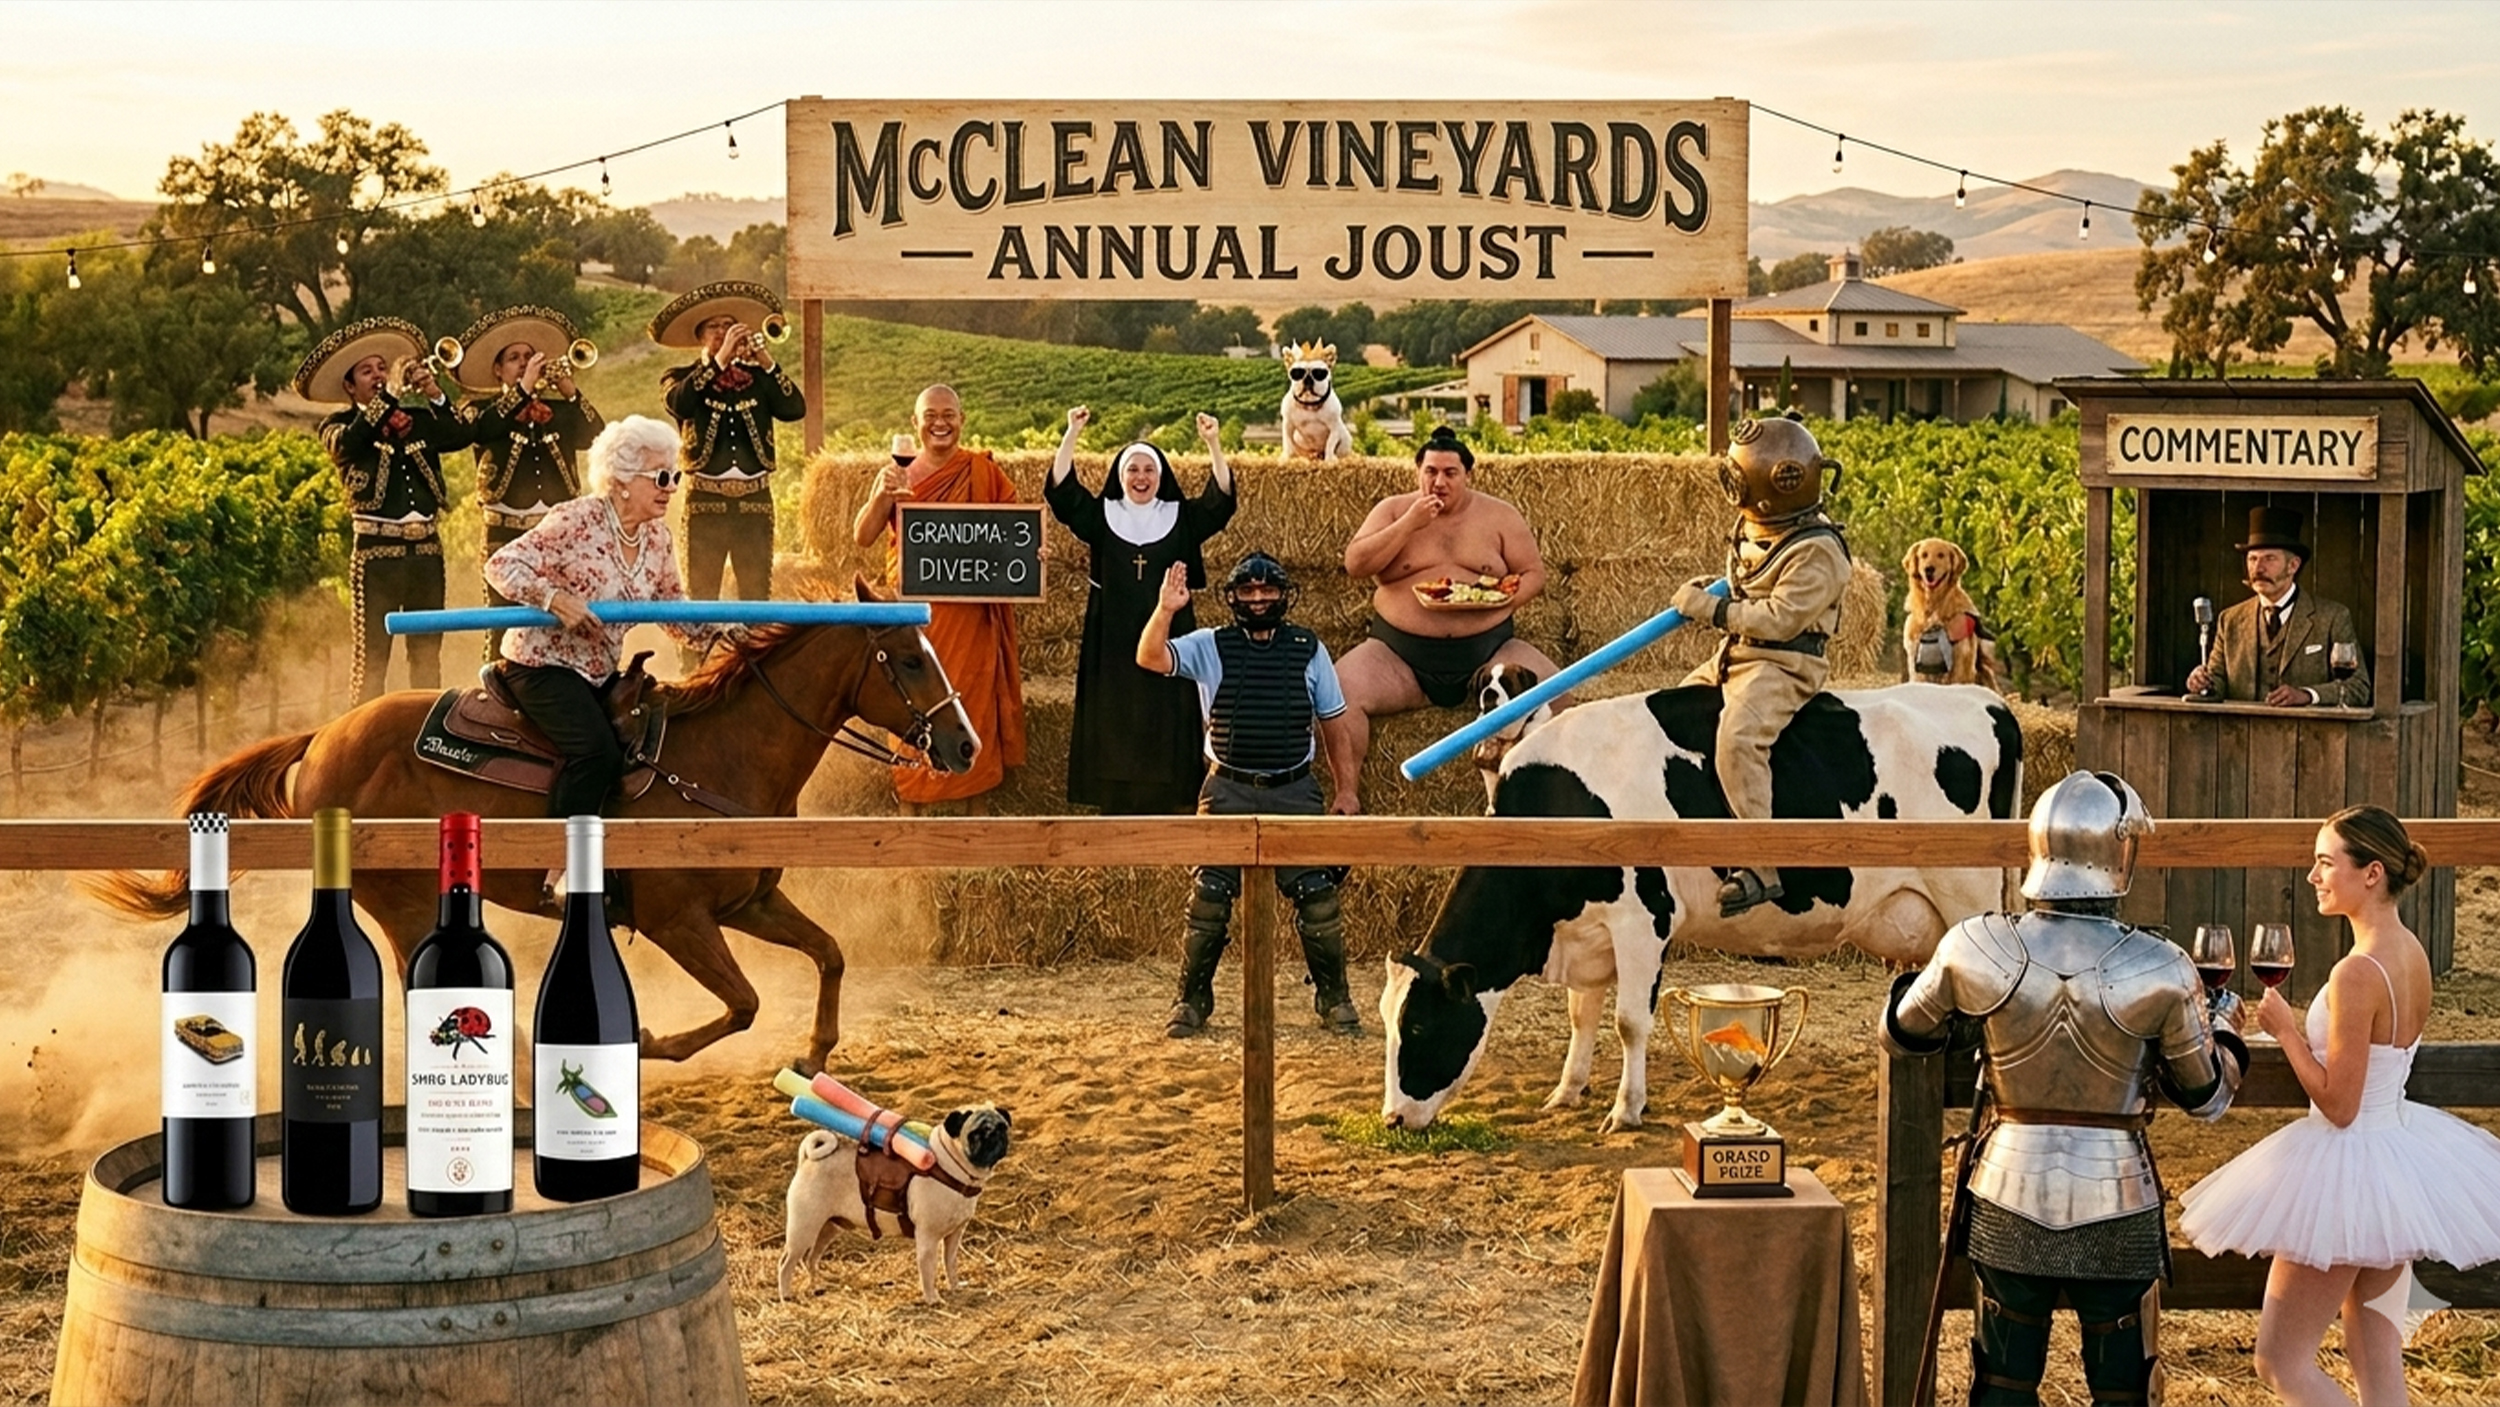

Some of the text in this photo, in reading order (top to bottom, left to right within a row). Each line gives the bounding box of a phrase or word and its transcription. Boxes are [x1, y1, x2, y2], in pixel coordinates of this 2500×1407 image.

[1248, 121, 1712, 235] VINEYARDS
[988, 225, 1566, 282] ANNUAL JOUST
[2119, 425, 2363, 466] COMMENTARY
[908, 521, 1031, 547] GRANDMA: 3
[919, 557, 1027, 583] DIVER: 0
[451, 1073, 508, 1086] LADYBUG
